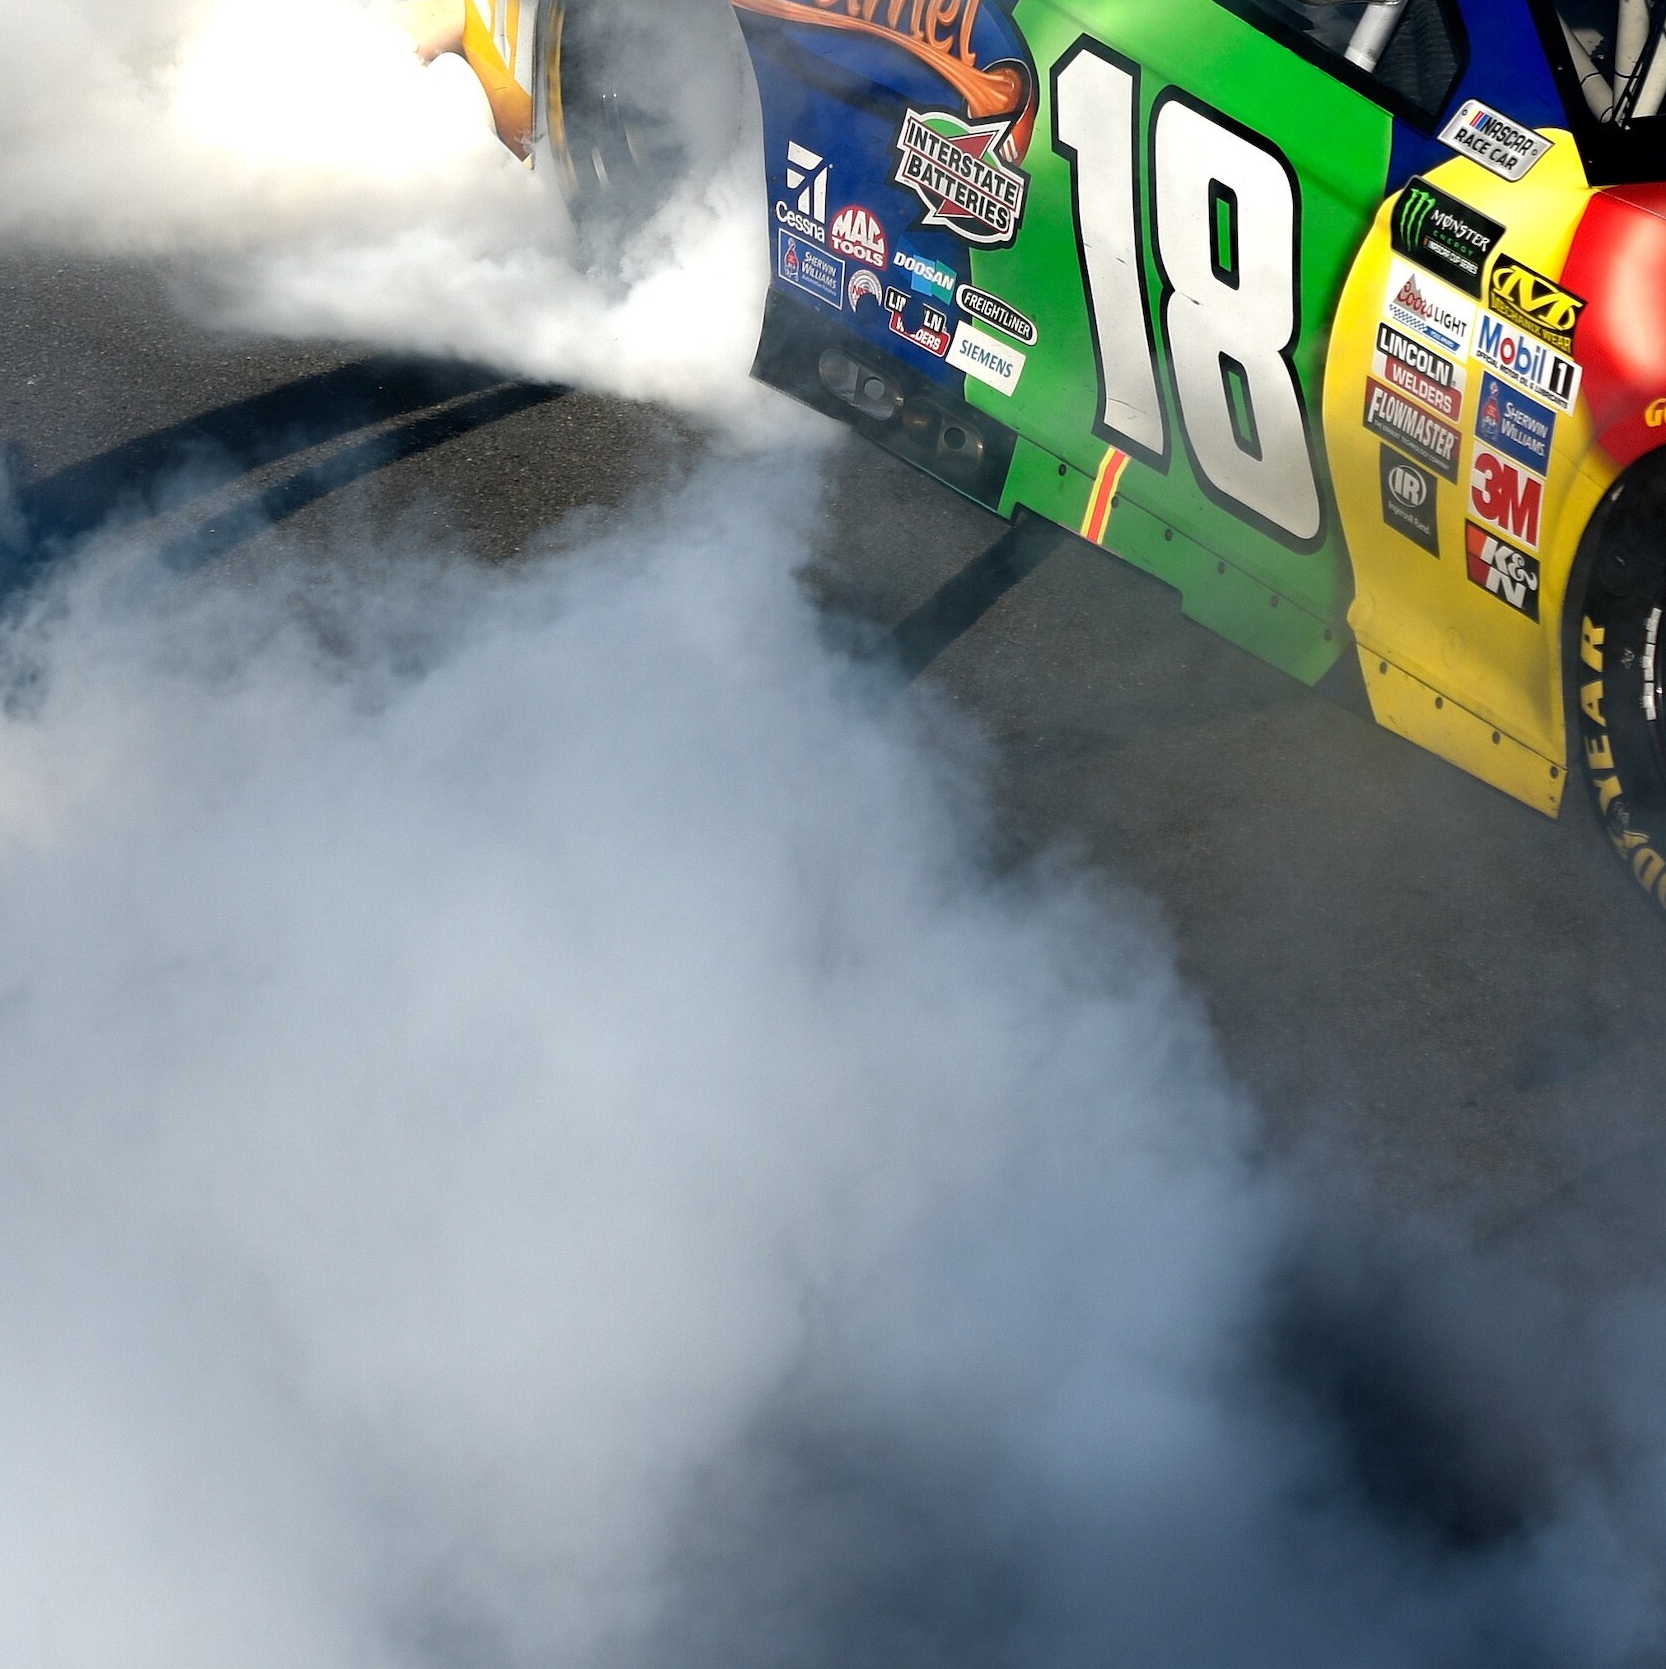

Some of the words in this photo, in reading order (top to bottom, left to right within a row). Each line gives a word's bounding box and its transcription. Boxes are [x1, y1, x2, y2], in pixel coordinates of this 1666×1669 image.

[1454, 128, 1491, 154] RACE
[1489, 149, 1518, 170] CAR
[1480, 117, 1534, 156] NASCAR
[907, 121, 1017, 206] INTERSTATE
[907, 153, 1009, 230] BATTERIES
[775, 200, 825, 243] Cessna
[832, 209, 884, 255] MAC
[832, 236, 884, 267] TOOLS
[1433, 229, 1475, 257] ENERGY
[802, 261, 837, 290] WILLIAMS
[804, 251, 837, 277] SHERWIN
[893, 252, 955, 291] DOOSAN
[1055, 46, 1323, 542] 18
[1397, 281, 1434, 319] Coors
[1434, 306, 1468, 337] LIGHT
[959, 339, 1014, 378] SIEMENS
[1379, 327, 1450, 387] LINCOLN
[1478, 315, 1547, 384] Mobil
[1541, 331, 1572, 354] WEAR
[1392, 363, 1452, 414] WELDERS
[1367, 386, 1455, 461] FLOWMASTER
[1501, 416, 1546, 457] WILLIAMS
[1503, 402, 1549, 439] SHERWIN
[1395, 467, 1421, 505] IR
[1471, 453, 1542, 547] 3M
[1388, 501, 1414, 525] Ingersoll
[1413, 515, 1430, 536] Rand
